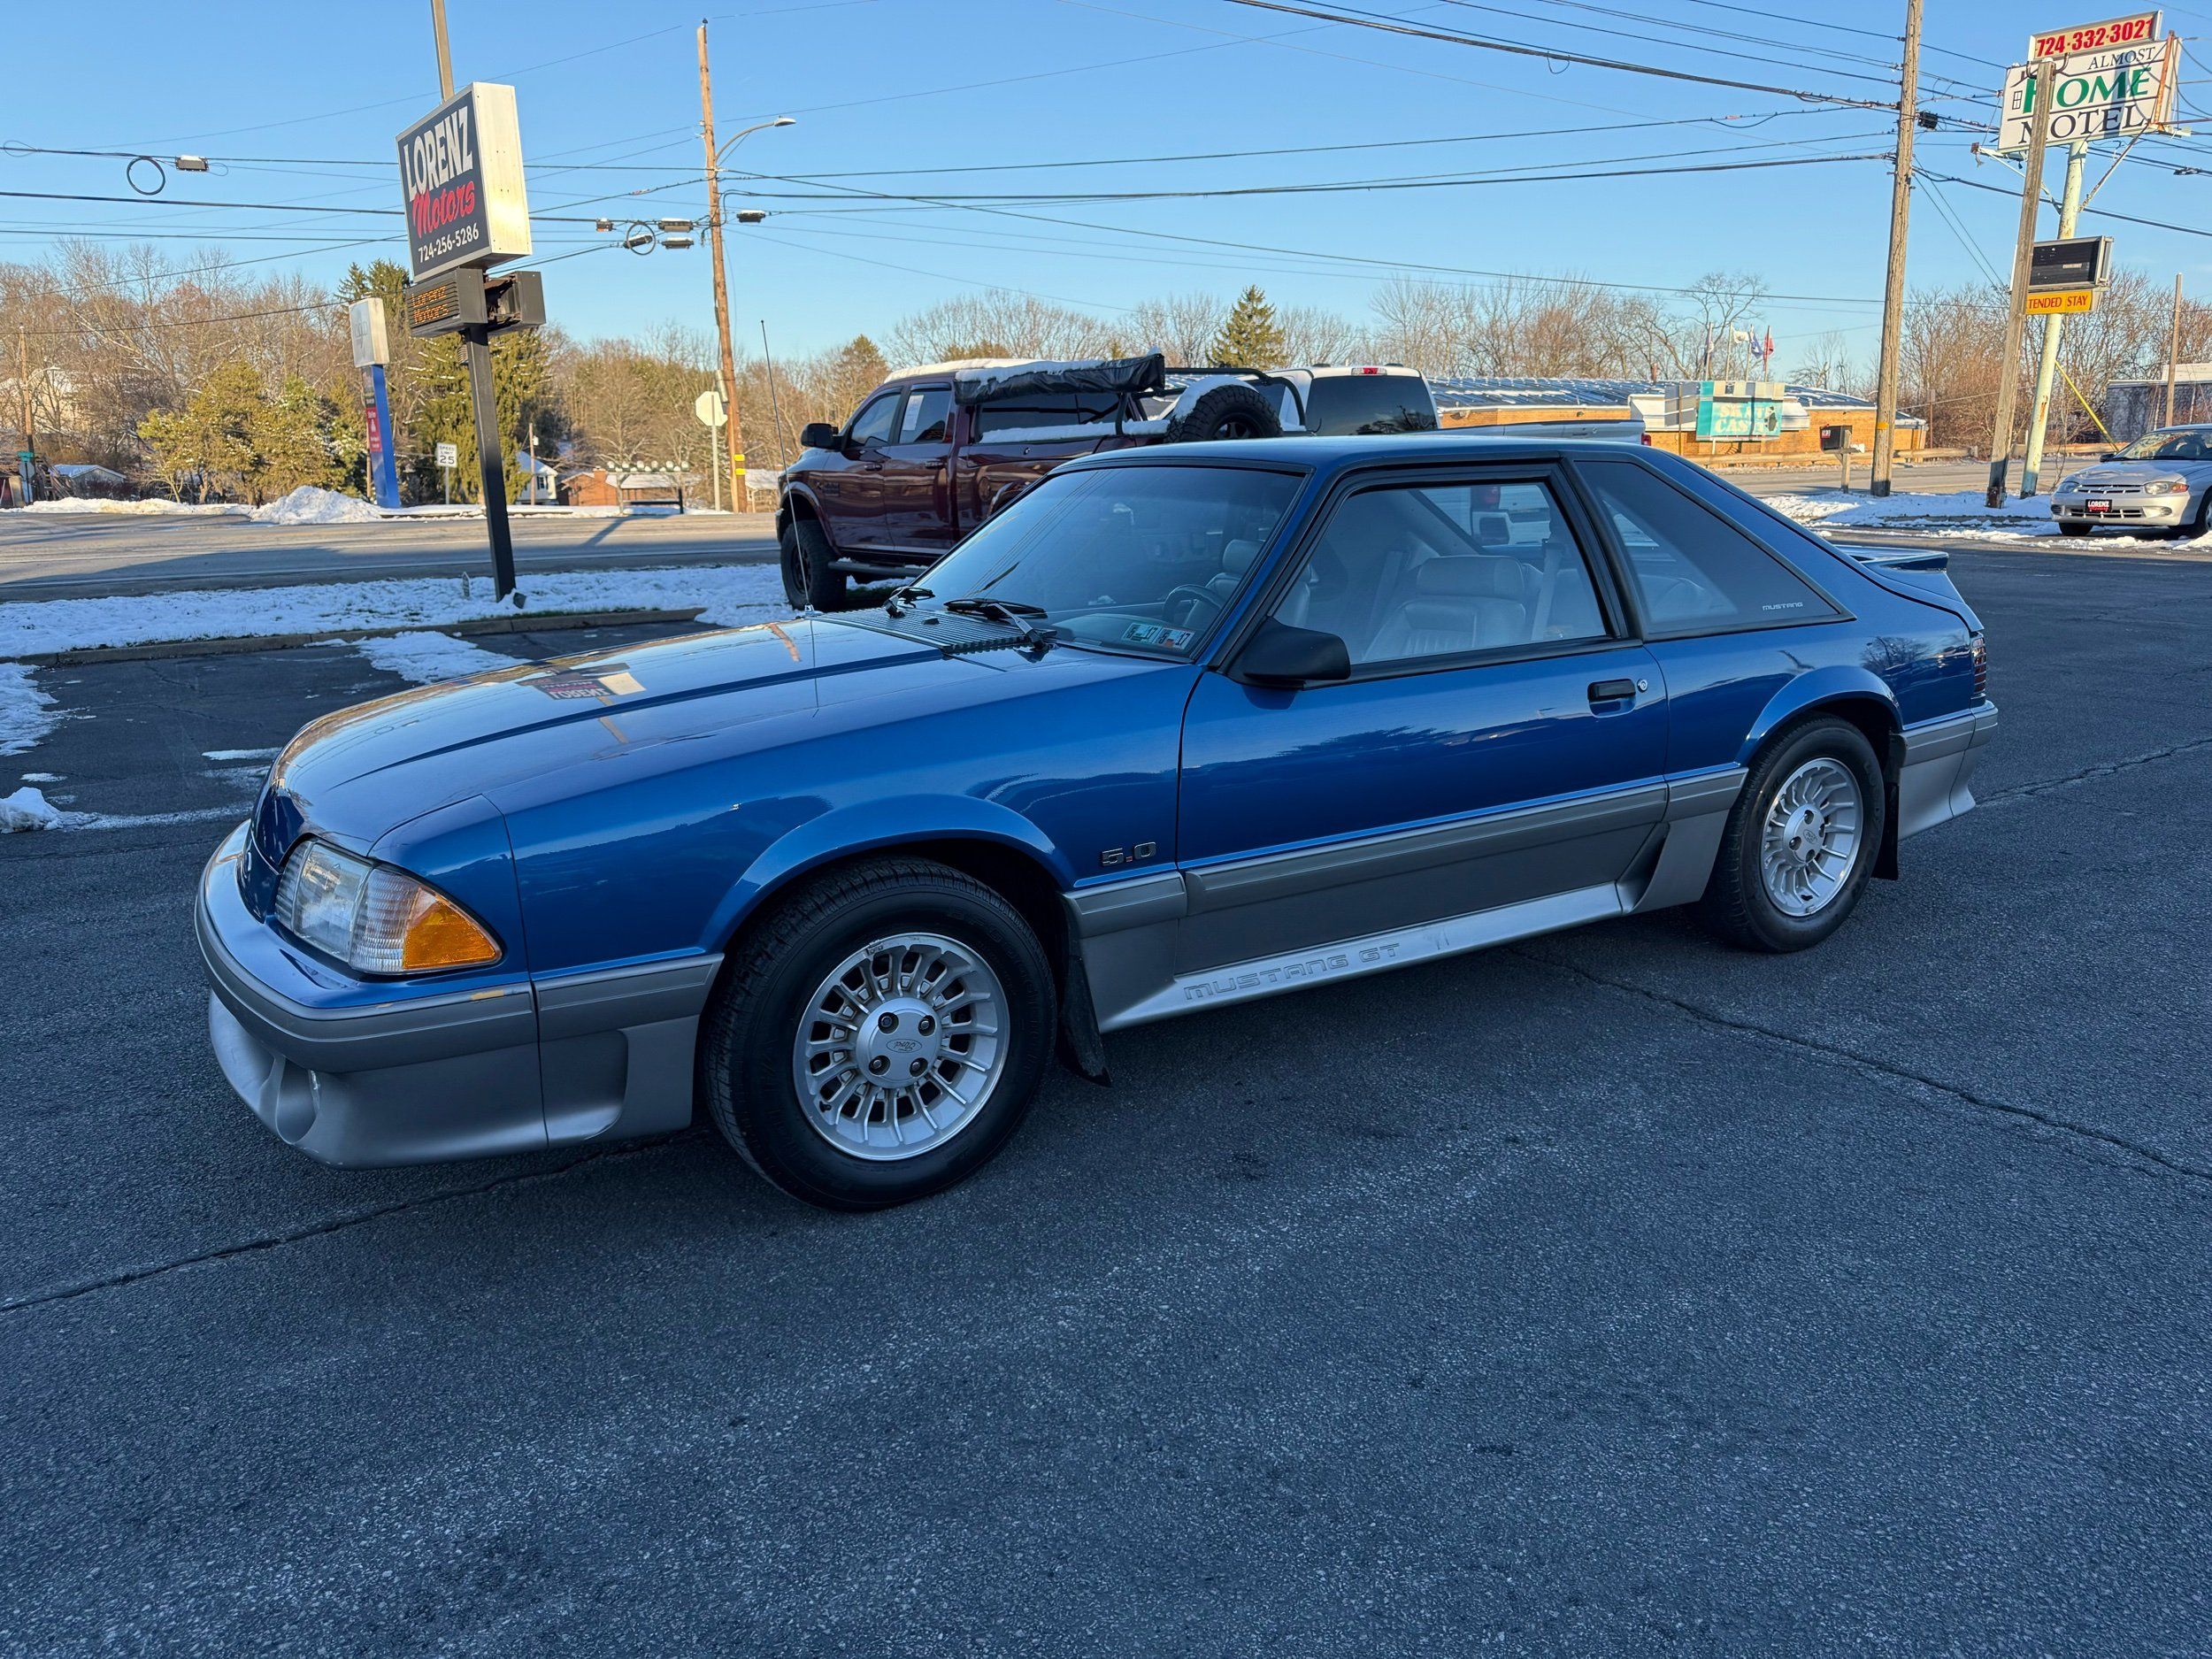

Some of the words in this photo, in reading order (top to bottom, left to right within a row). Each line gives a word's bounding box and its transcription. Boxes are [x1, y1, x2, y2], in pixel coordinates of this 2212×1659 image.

[2087, 46, 2156, 70] ALMOST
[403, 105, 473, 203] LORENZ
[411, 180, 476, 240] Motors
[418, 223, 480, 264] 724-256-5286
[2029, 296, 2062, 309] TENDED
[2067, 295, 2088, 307] STAY
[439, 455, 454, 464] 25
[1762, 602, 1803, 611] MUSTANG
[1102, 841, 1156, 866] 5.0
[1183, 954, 1349, 1001] MUSTANG
[1358, 943, 1401, 964] GT
